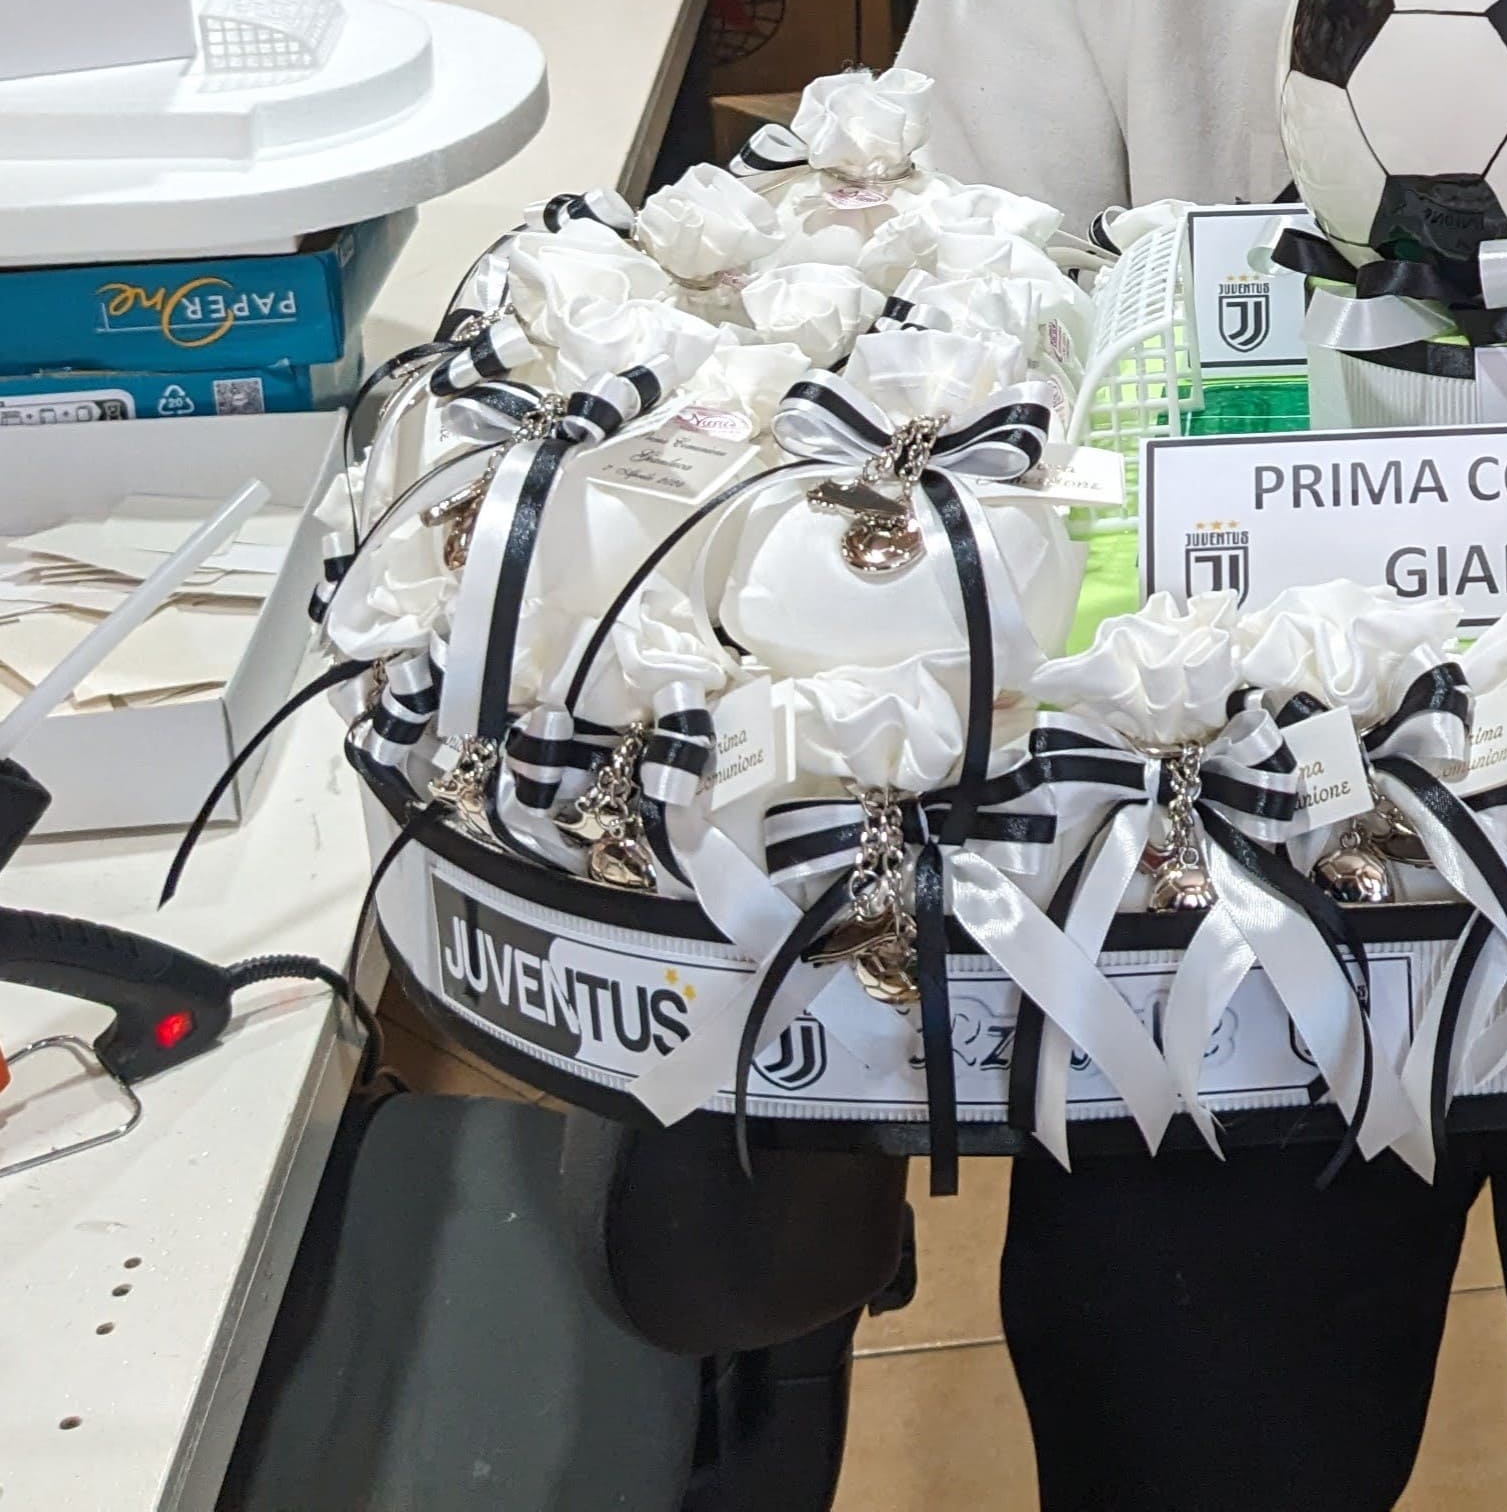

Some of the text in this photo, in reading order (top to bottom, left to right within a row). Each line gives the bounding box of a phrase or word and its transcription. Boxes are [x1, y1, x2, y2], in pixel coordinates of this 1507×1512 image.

[1218, 282, 1270, 295] JUVENTUS
[97, 276, 297, 348] PAPER One
[1254, 459, 1449, 510] PRIMA
[1185, 530, 1249, 547] JUVENTUS
[717, 729, 748, 755] rima
[1468, 724, 1504, 746] rima
[444, 915, 692, 1057] JUVENTUS
